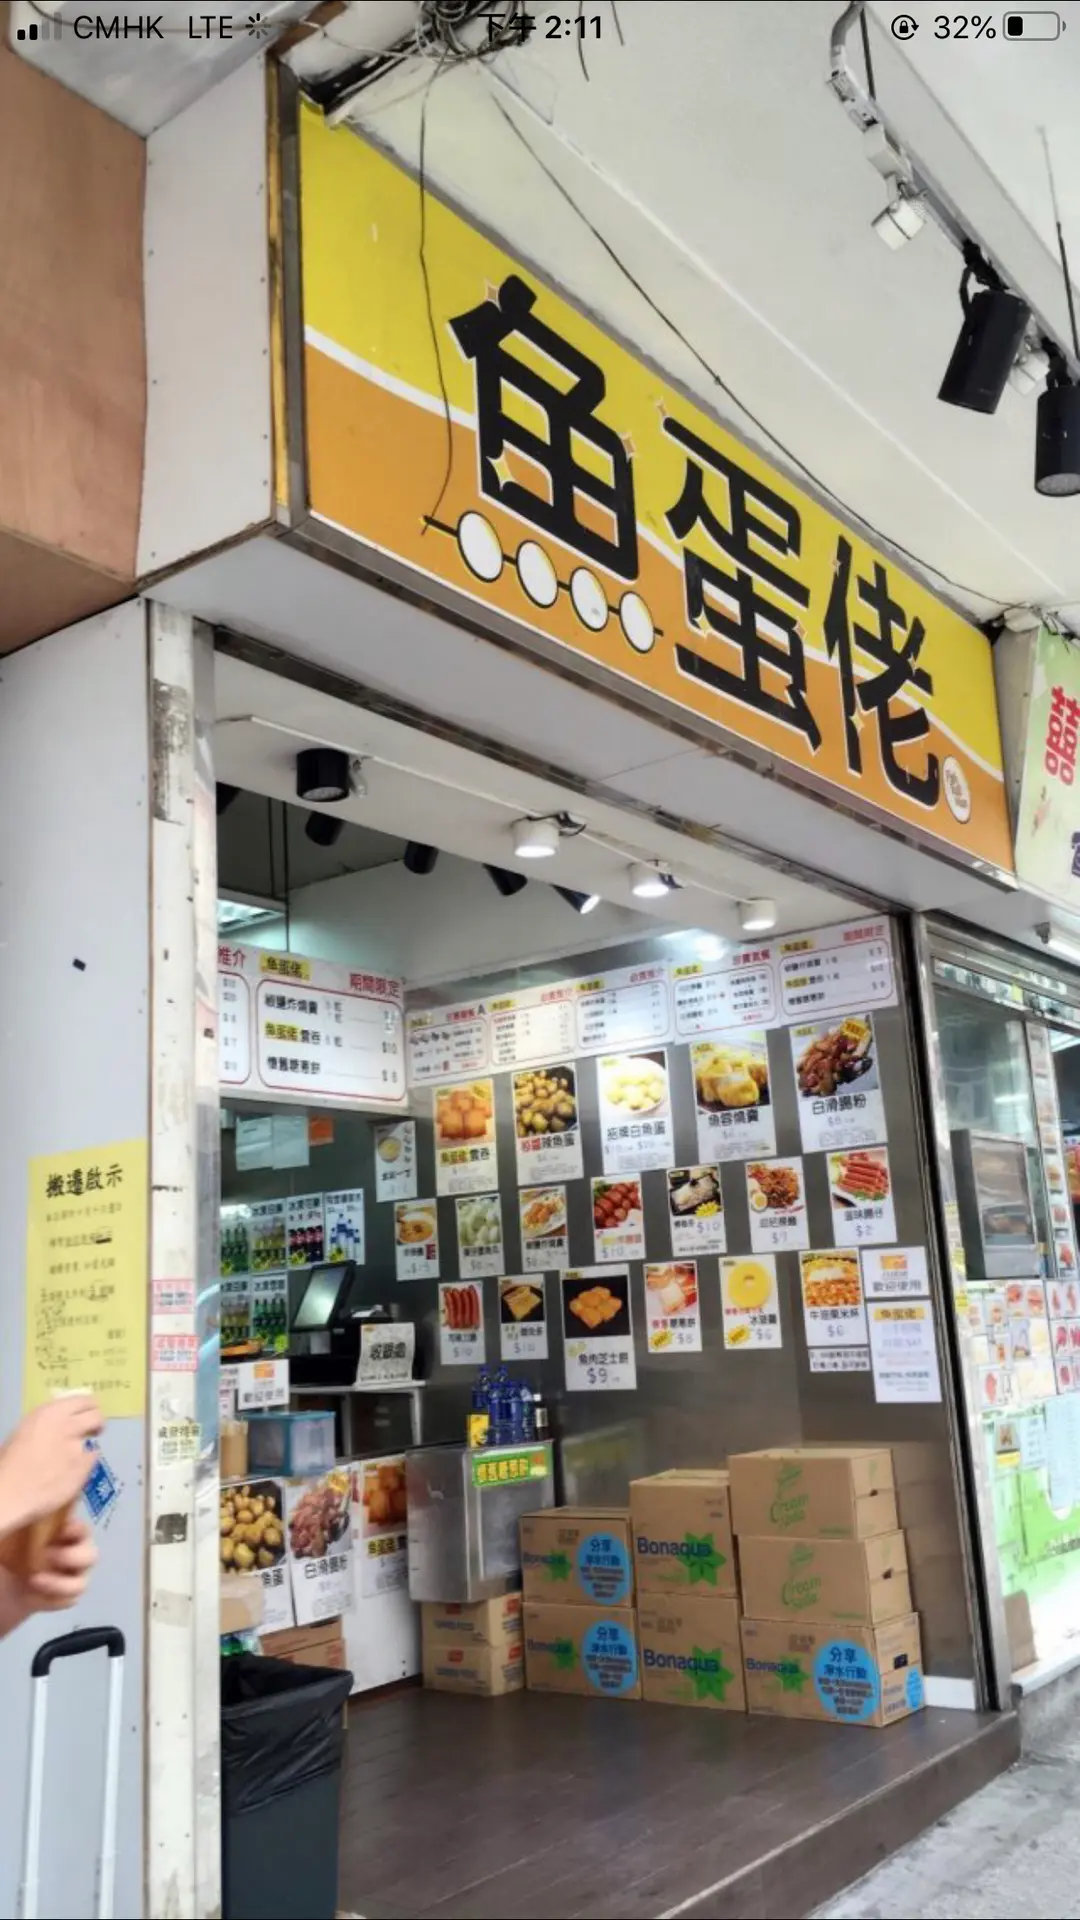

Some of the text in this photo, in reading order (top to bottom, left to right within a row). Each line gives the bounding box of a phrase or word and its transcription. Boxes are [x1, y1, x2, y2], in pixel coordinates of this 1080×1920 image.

[448, 274, 941, 810] 魚蛋佬
[636, 1536, 713, 1559] Bonaqua
[643, 1648, 720, 1673] Bonaqua
[829, 1646, 857, 1664] 分享
